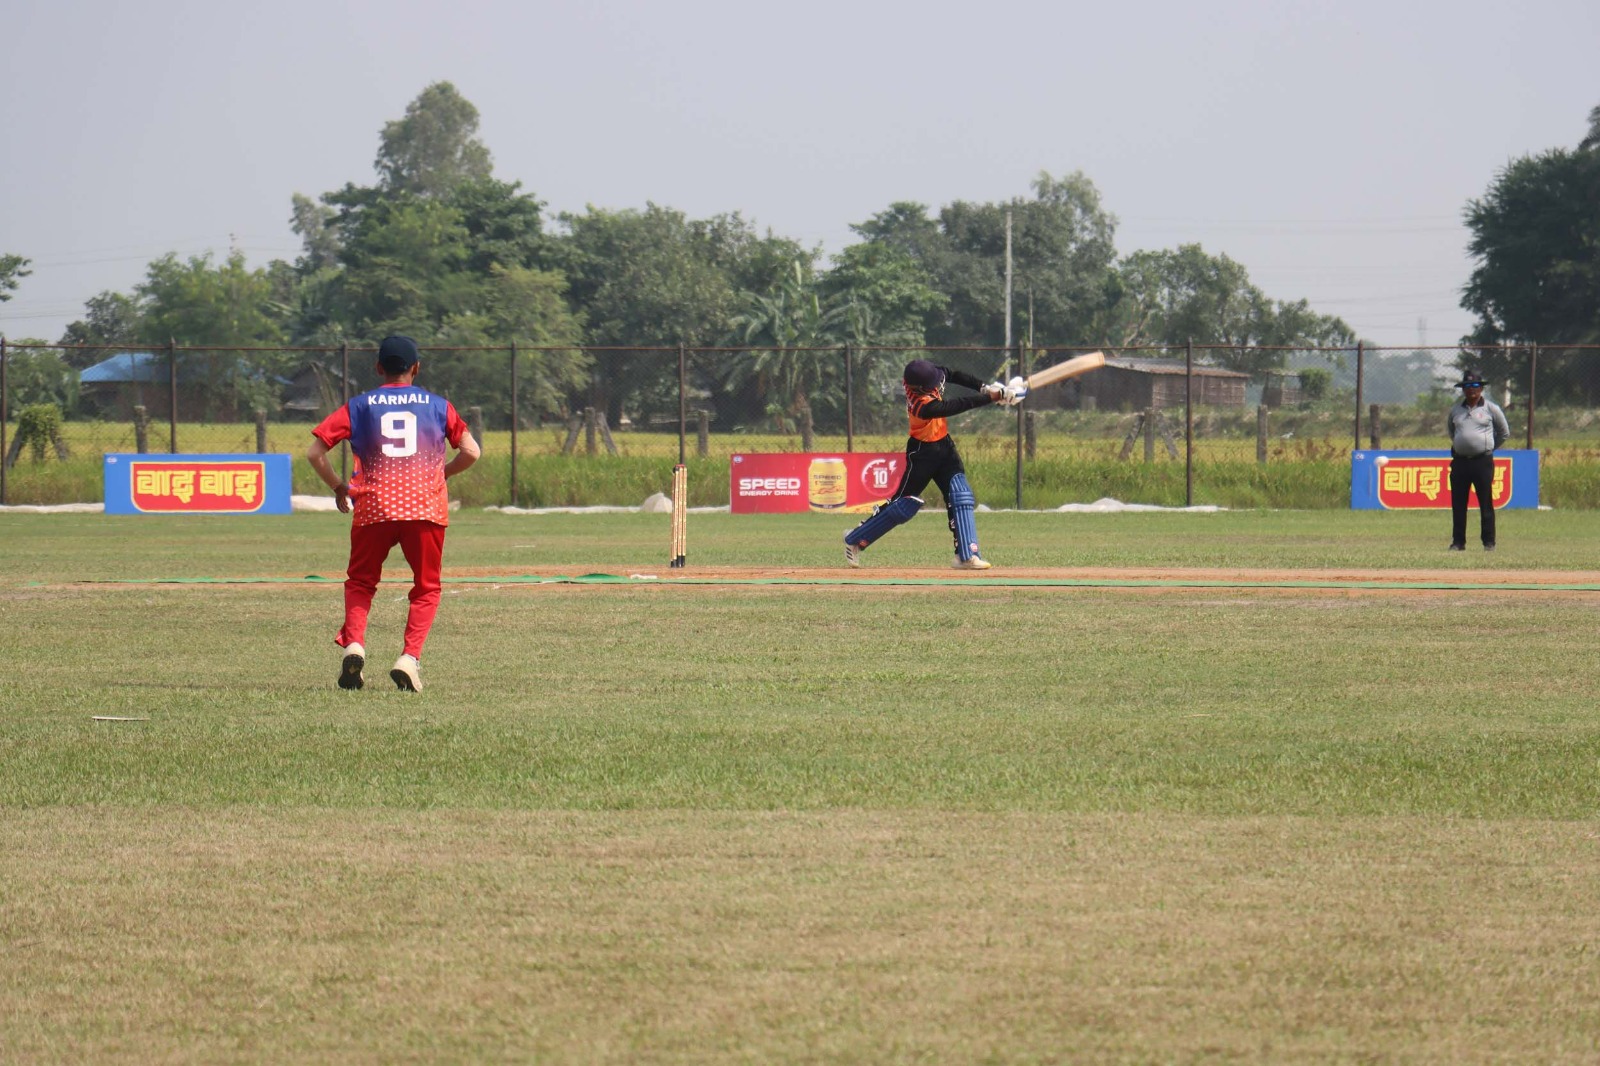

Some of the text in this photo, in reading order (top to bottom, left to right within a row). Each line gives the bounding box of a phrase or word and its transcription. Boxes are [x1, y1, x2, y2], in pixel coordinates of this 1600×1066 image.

[368, 393, 430, 405] KARNALI
[381, 411, 417, 457] 9
[739, 478, 801, 490] SPEED
[873, 470, 888, 485] 10
